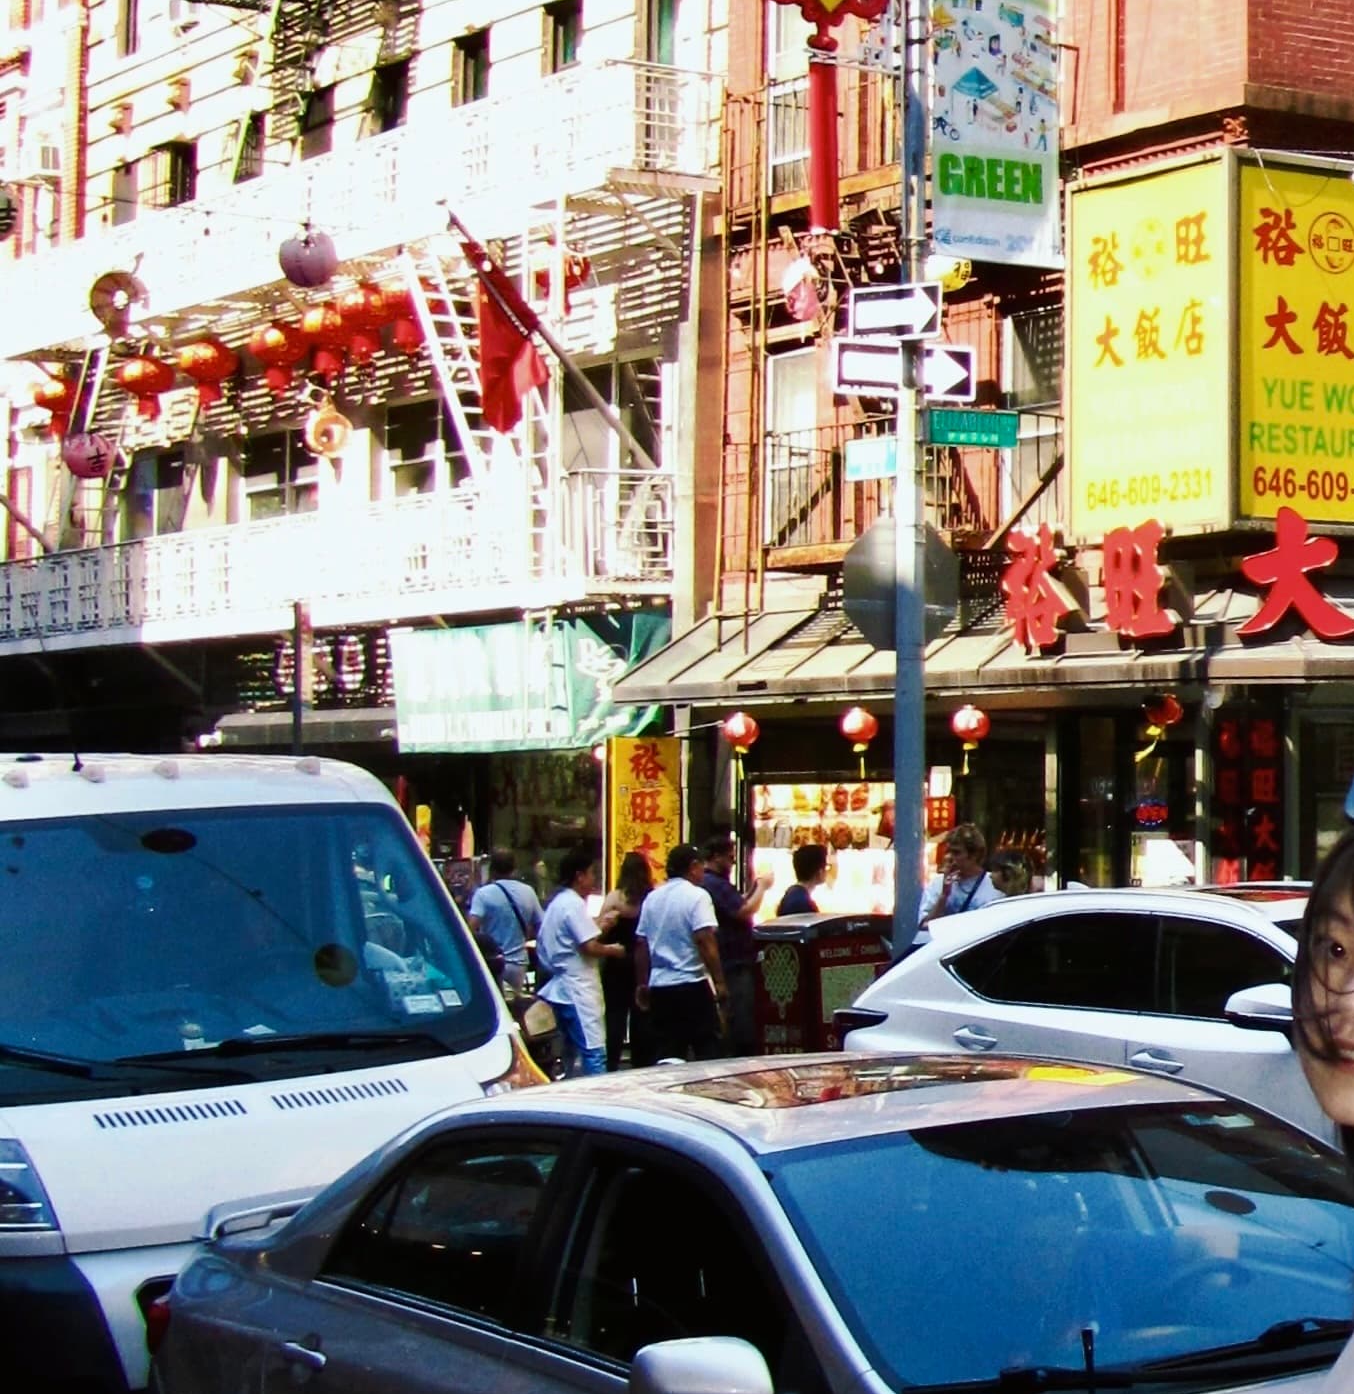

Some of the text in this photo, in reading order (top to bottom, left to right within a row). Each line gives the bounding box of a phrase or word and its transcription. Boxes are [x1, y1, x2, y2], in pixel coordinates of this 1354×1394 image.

[938, 152, 1043, 205] GREEN
[1251, 207, 1306, 267] 裕
[1261, 376, 1315, 411] YUE
[1086, 467, 1213, 512] 646-609-2331
